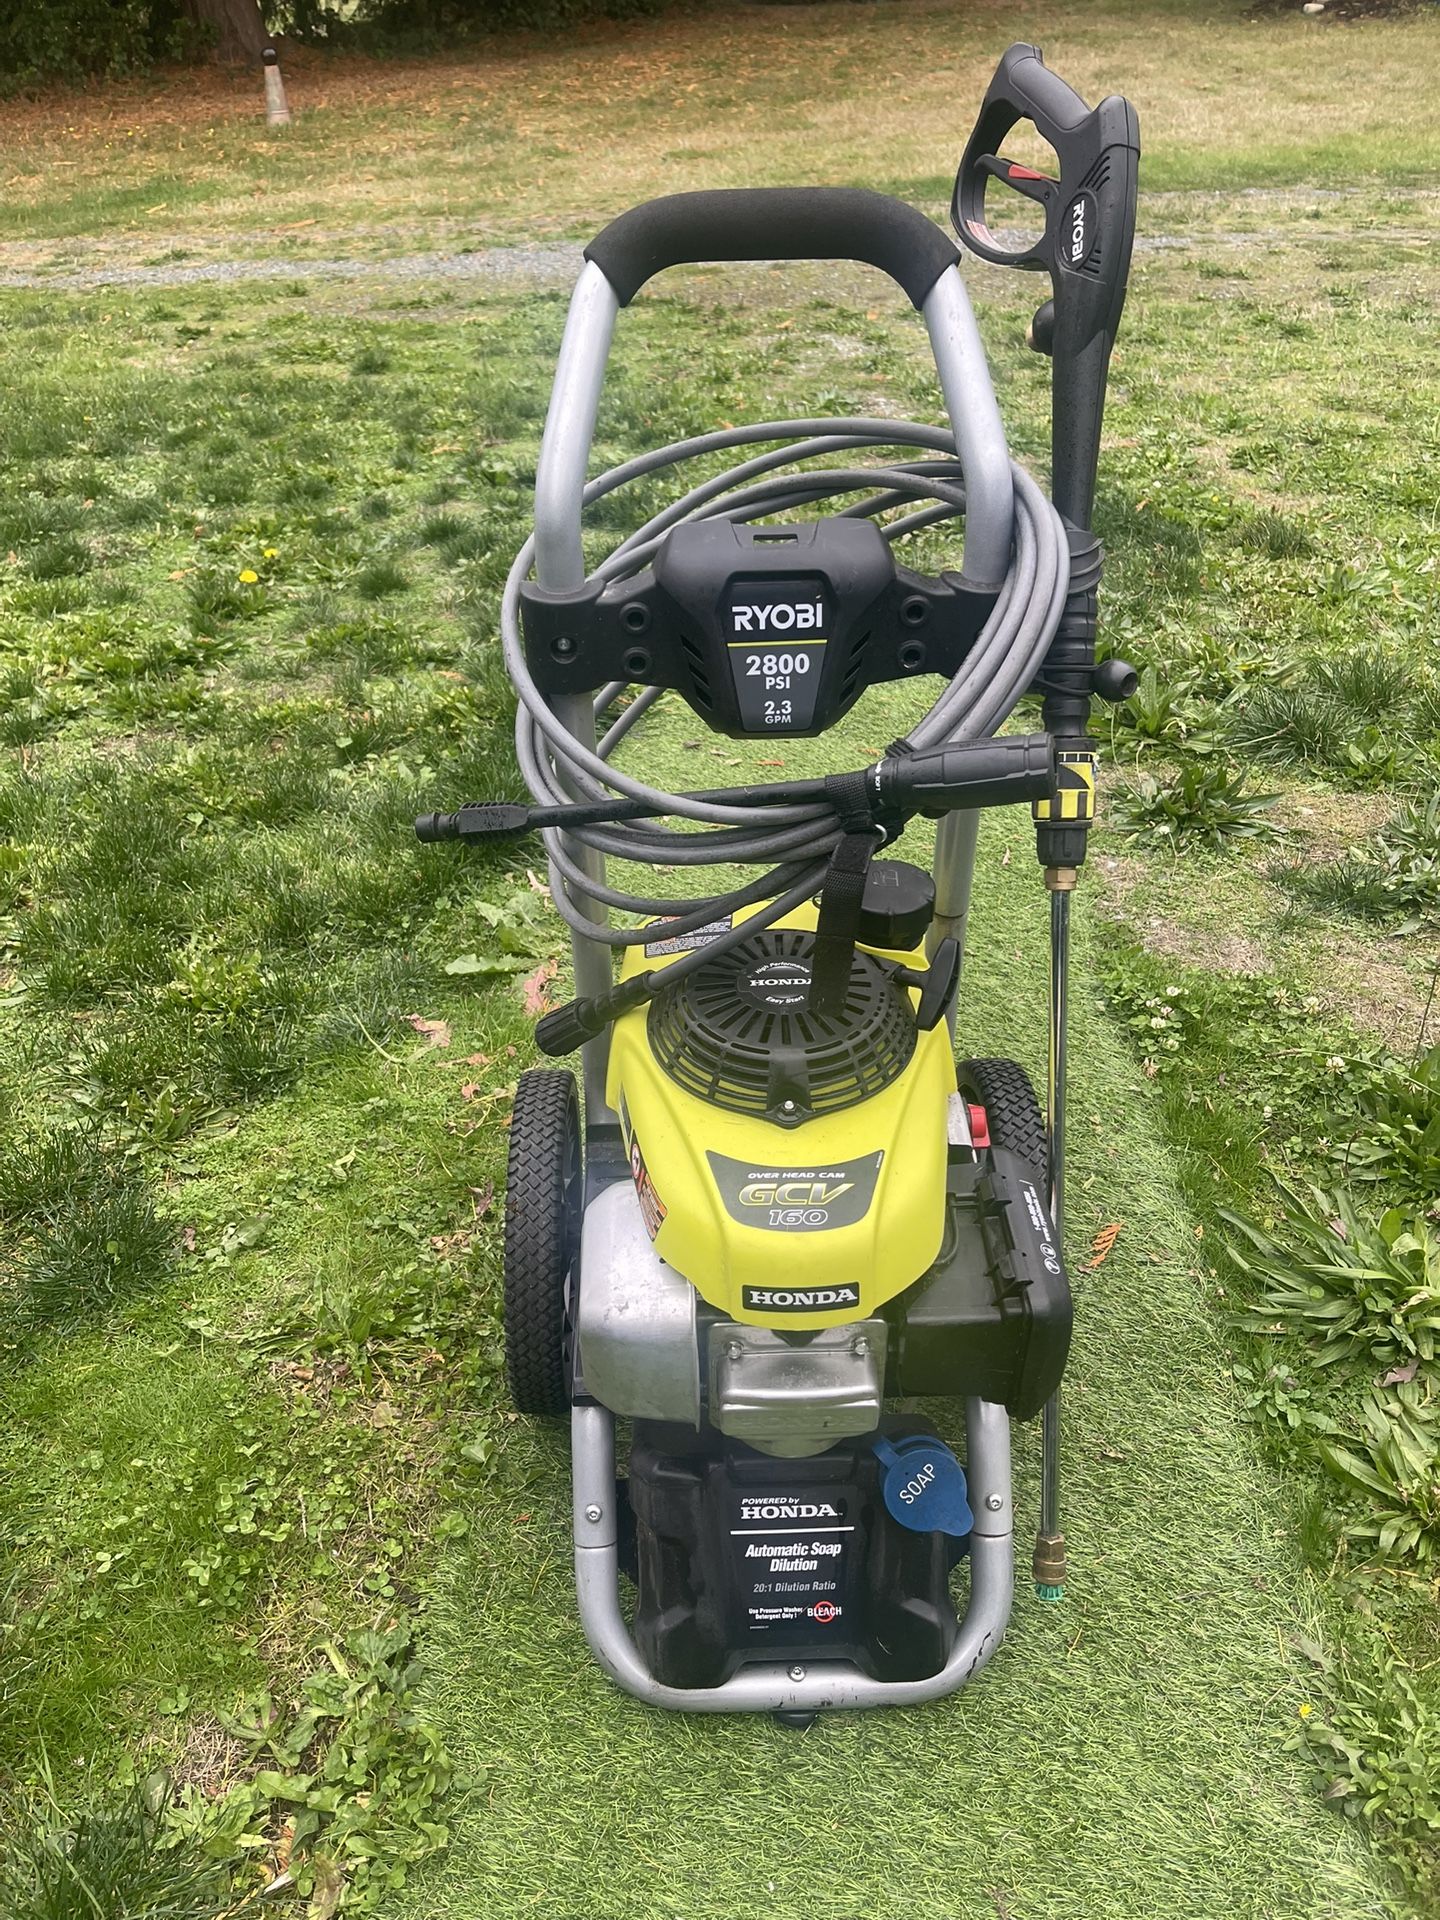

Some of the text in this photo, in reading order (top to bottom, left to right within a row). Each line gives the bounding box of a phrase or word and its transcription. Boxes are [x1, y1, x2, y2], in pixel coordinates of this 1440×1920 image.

[1072, 199, 1085, 262] RYOBI
[731, 602, 823, 631] RYOBI
[745, 653, 811, 676] 2800
[765, 676, 791, 690] PSI
[764, 700, 792, 715] 2.3
[764, 715, 792, 724] GPM
[738, 1182, 856, 1206] GCV
[768, 1209, 829, 1226] 160
[749, 1288, 858, 1306] HONDA
[899, 1463, 936, 1505] SOAP
[741, 1497, 788, 1505] POWERED
[740, 1504, 838, 1519] HONDA
[744, 1541, 842, 1557] Automatic Soap
[769, 1558, 818, 1572] Dilution
[753, 1580, 837, 1593] 20:1 Dilution Ratio
[807, 1606, 842, 1617] BLEACH
